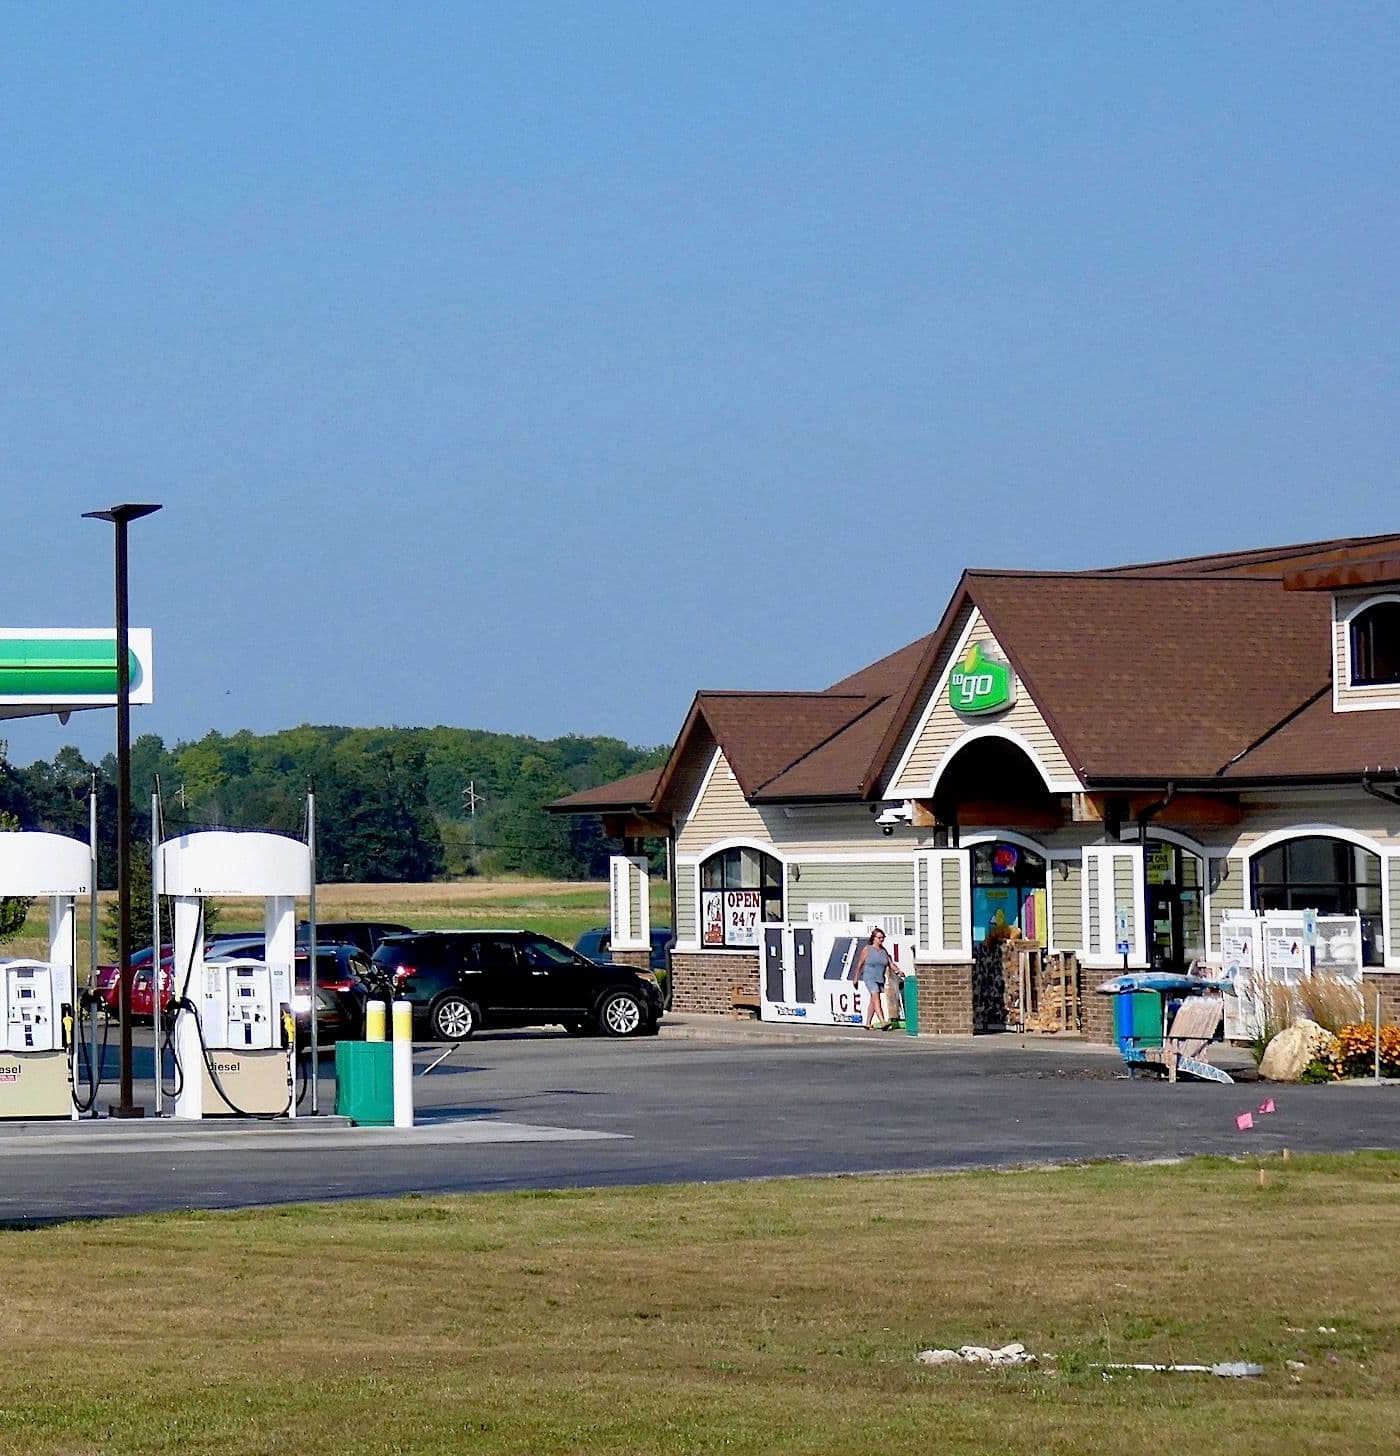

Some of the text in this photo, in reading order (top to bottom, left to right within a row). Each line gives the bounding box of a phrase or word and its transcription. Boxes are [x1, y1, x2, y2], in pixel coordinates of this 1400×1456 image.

[960, 675, 993, 704] go
[728, 892, 760, 908] OPEN
[732, 911, 756, 927] 24/7
[812, 911, 823, 921] ICE
[830, 993, 862, 1014] ICE
